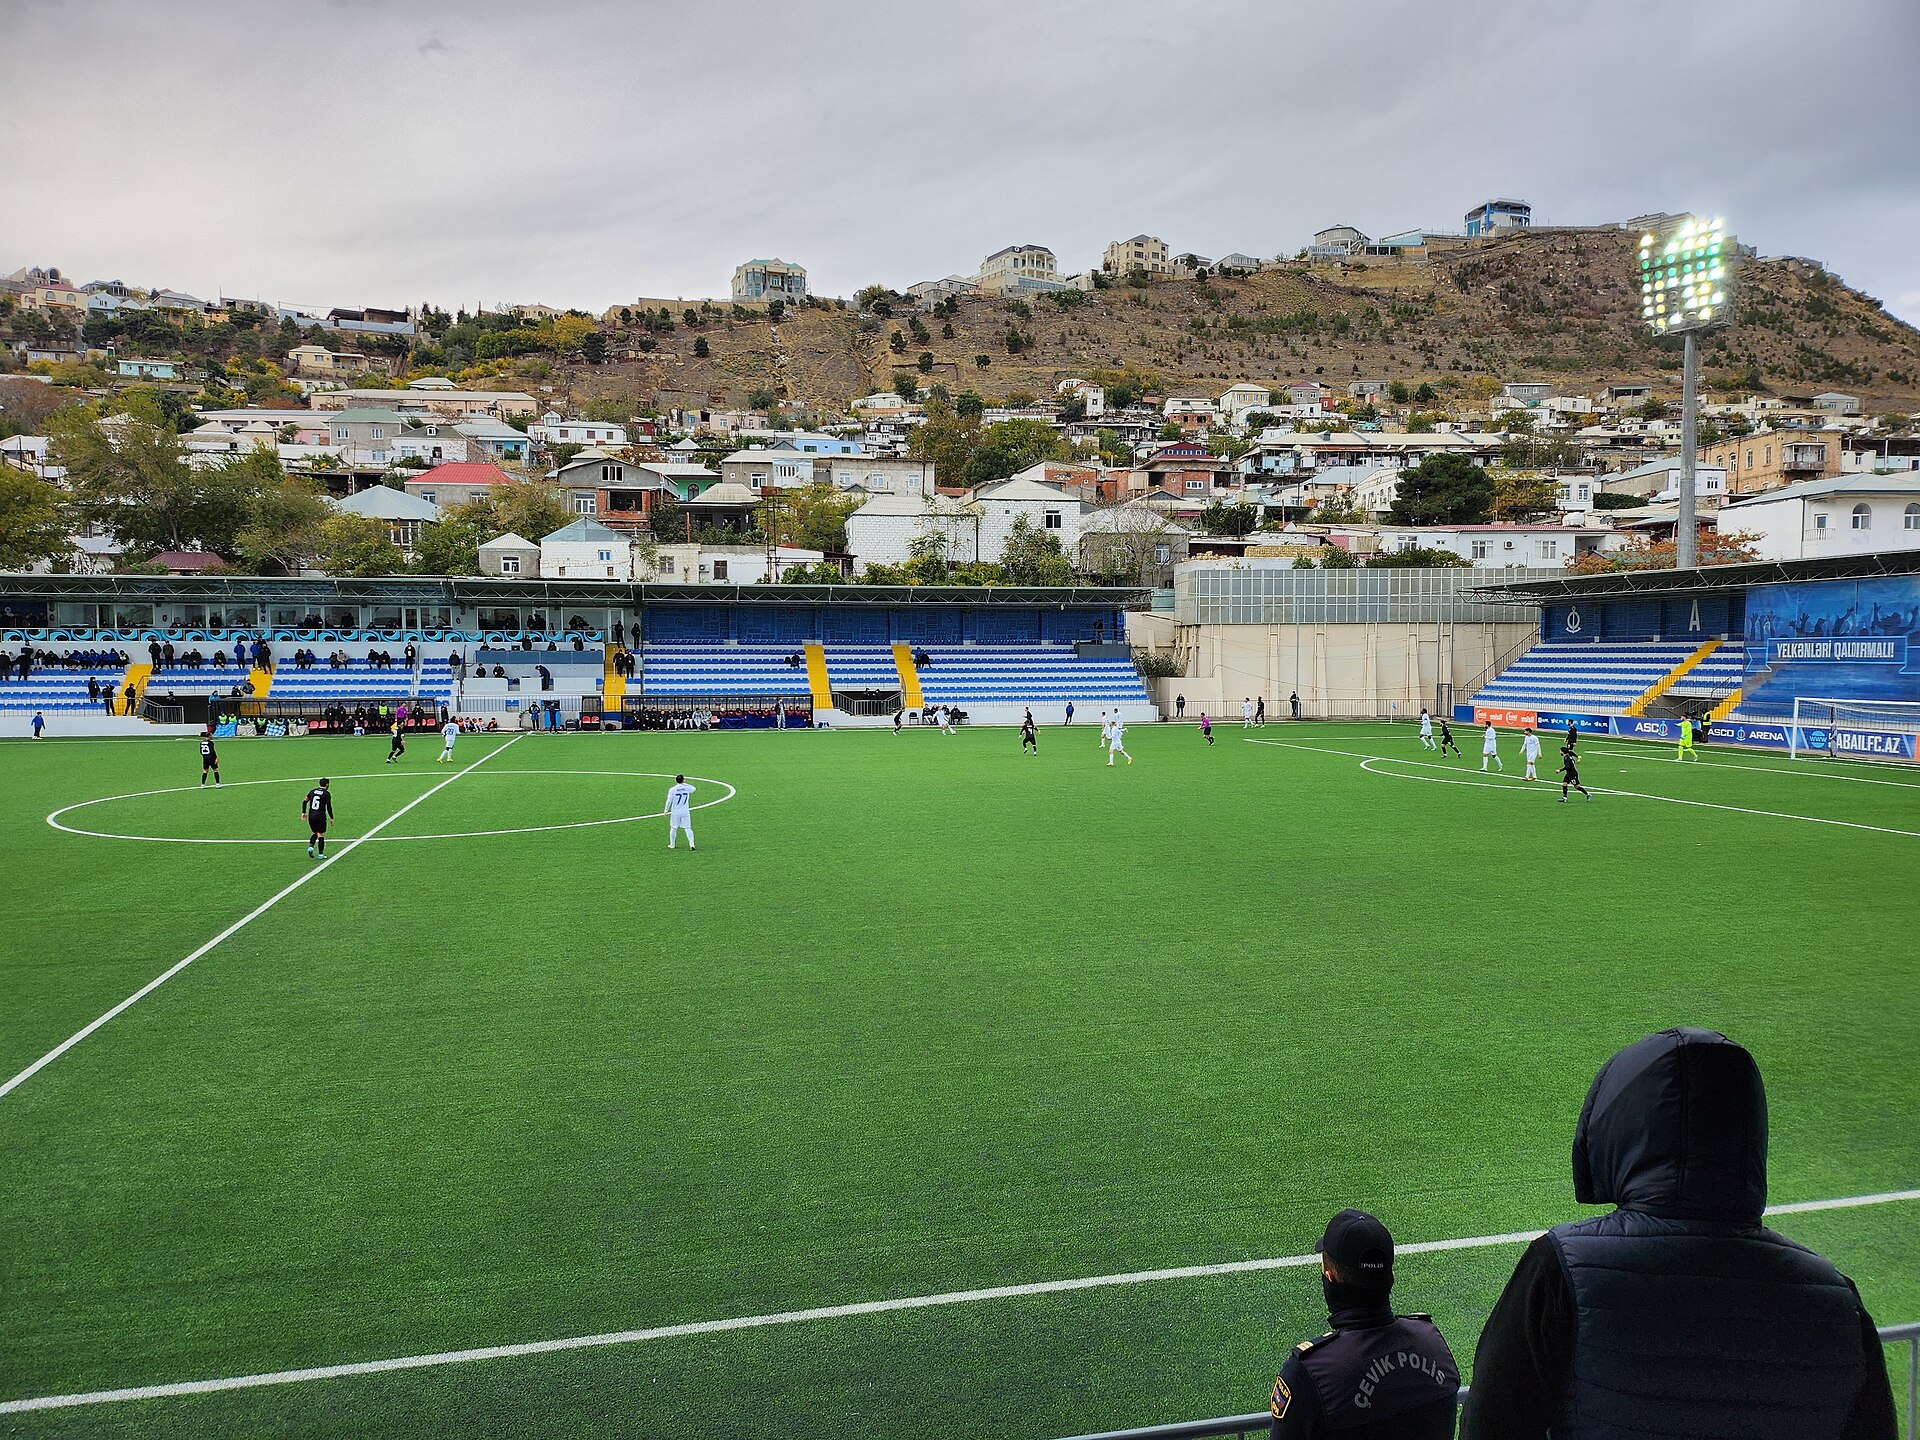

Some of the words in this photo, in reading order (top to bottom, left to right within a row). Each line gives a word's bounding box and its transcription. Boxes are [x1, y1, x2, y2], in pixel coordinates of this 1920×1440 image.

[1776, 640, 1832, 658] YELKƏNLƏRİ
[1833, 642, 1894, 660] QALDIRMALI!
[1707, 727, 1735, 738] ASCO
[1749, 730, 1784, 741] ARENA
[311, 795, 321, 810] 6
[675, 793, 688, 805] 77
[1353, 1354, 1396, 1409] ÇEVİK
[1397, 1351, 1446, 1385] POLİS
